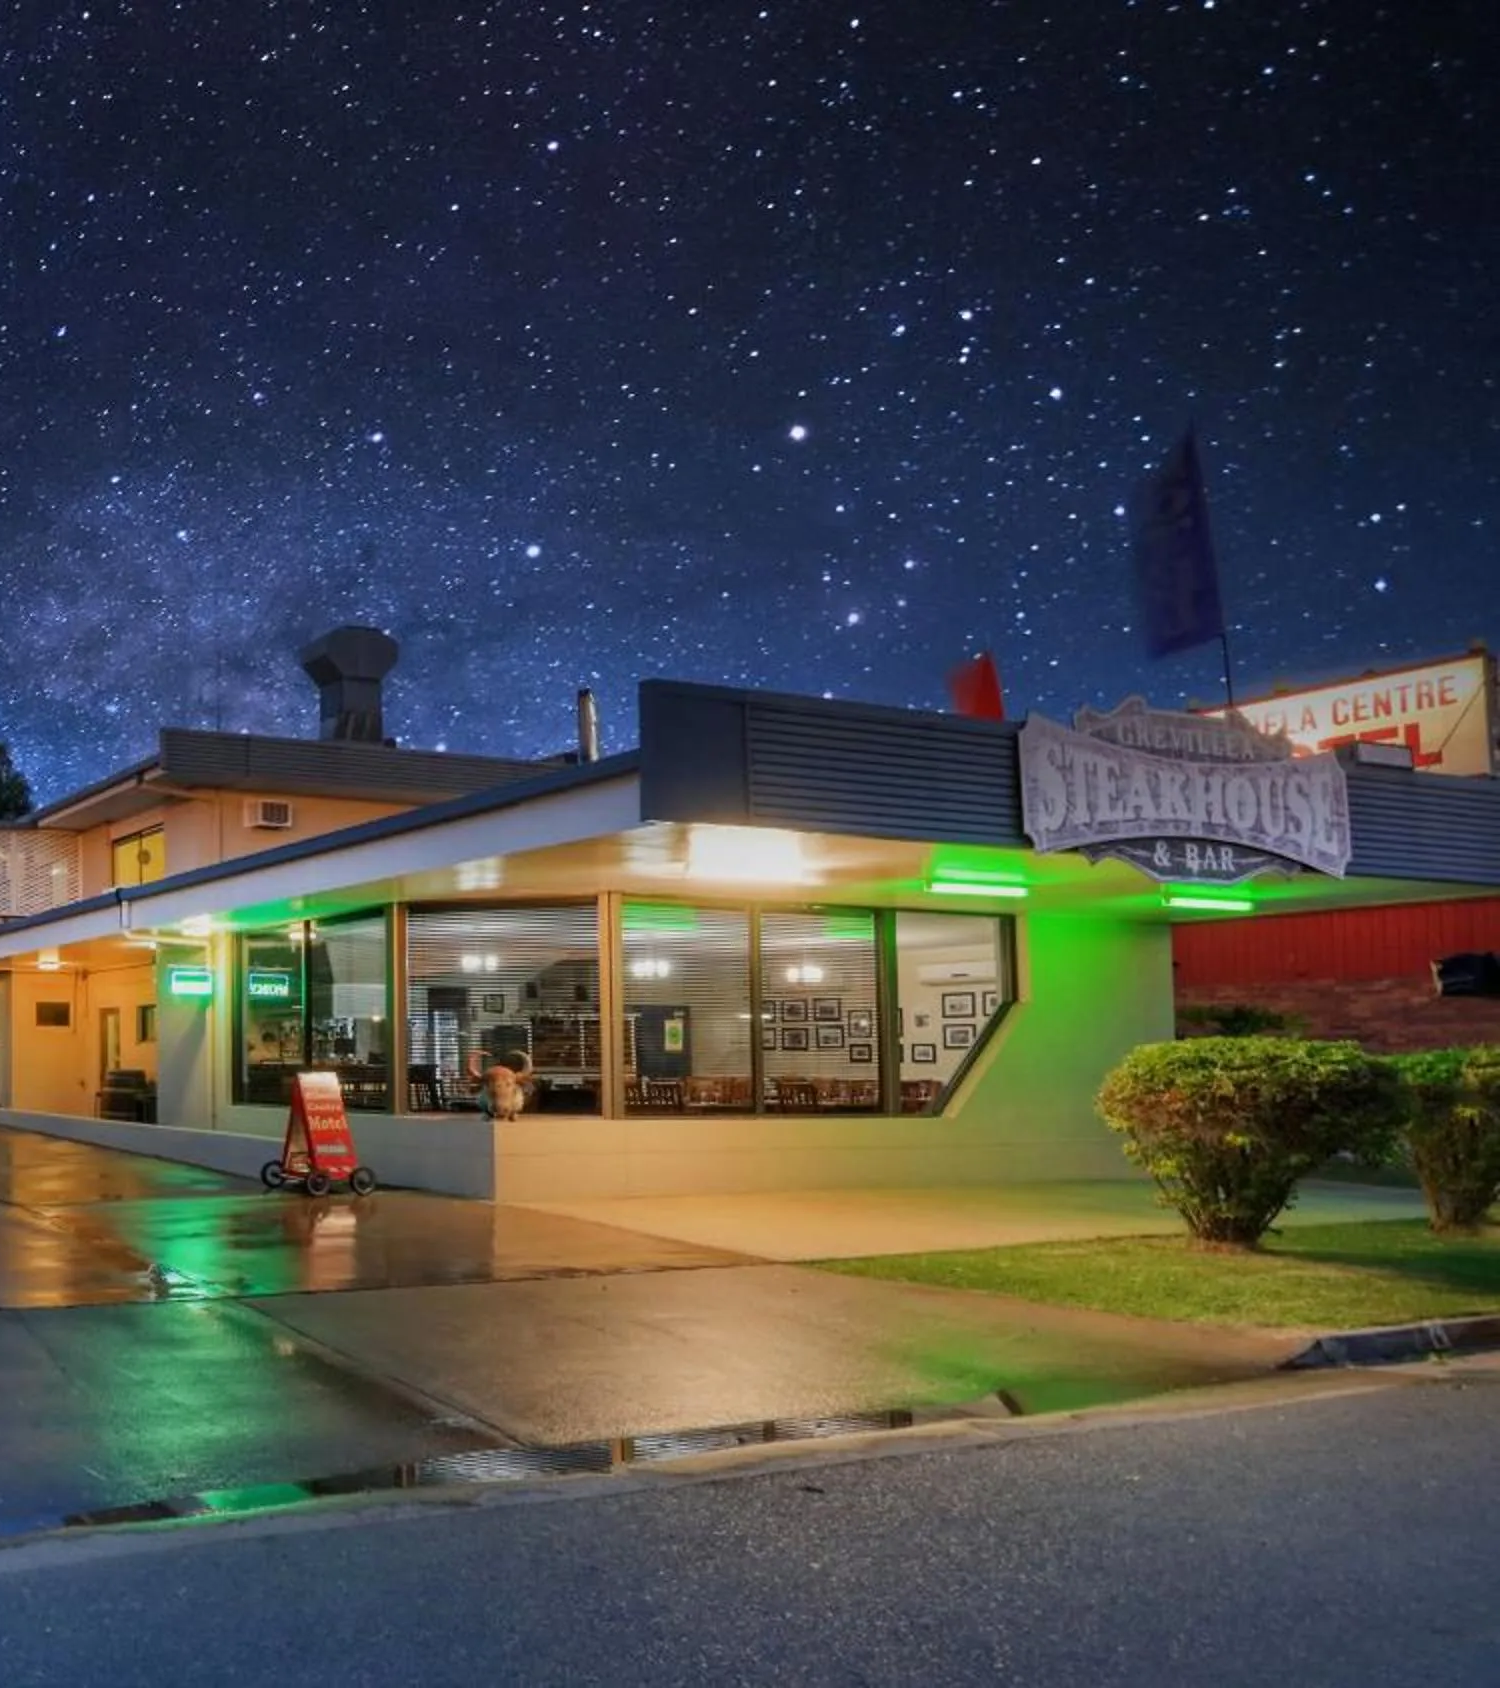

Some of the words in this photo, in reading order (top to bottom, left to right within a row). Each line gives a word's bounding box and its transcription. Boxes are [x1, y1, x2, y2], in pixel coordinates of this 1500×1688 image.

[1331, 675, 1459, 727] CENTRE
[1037, 743, 1339, 856] STEAKHOUSE
[1152, 840, 1172, 867] &
[1185, 844, 1236, 873] BAR
[308, 1115, 348, 1131] Motel
